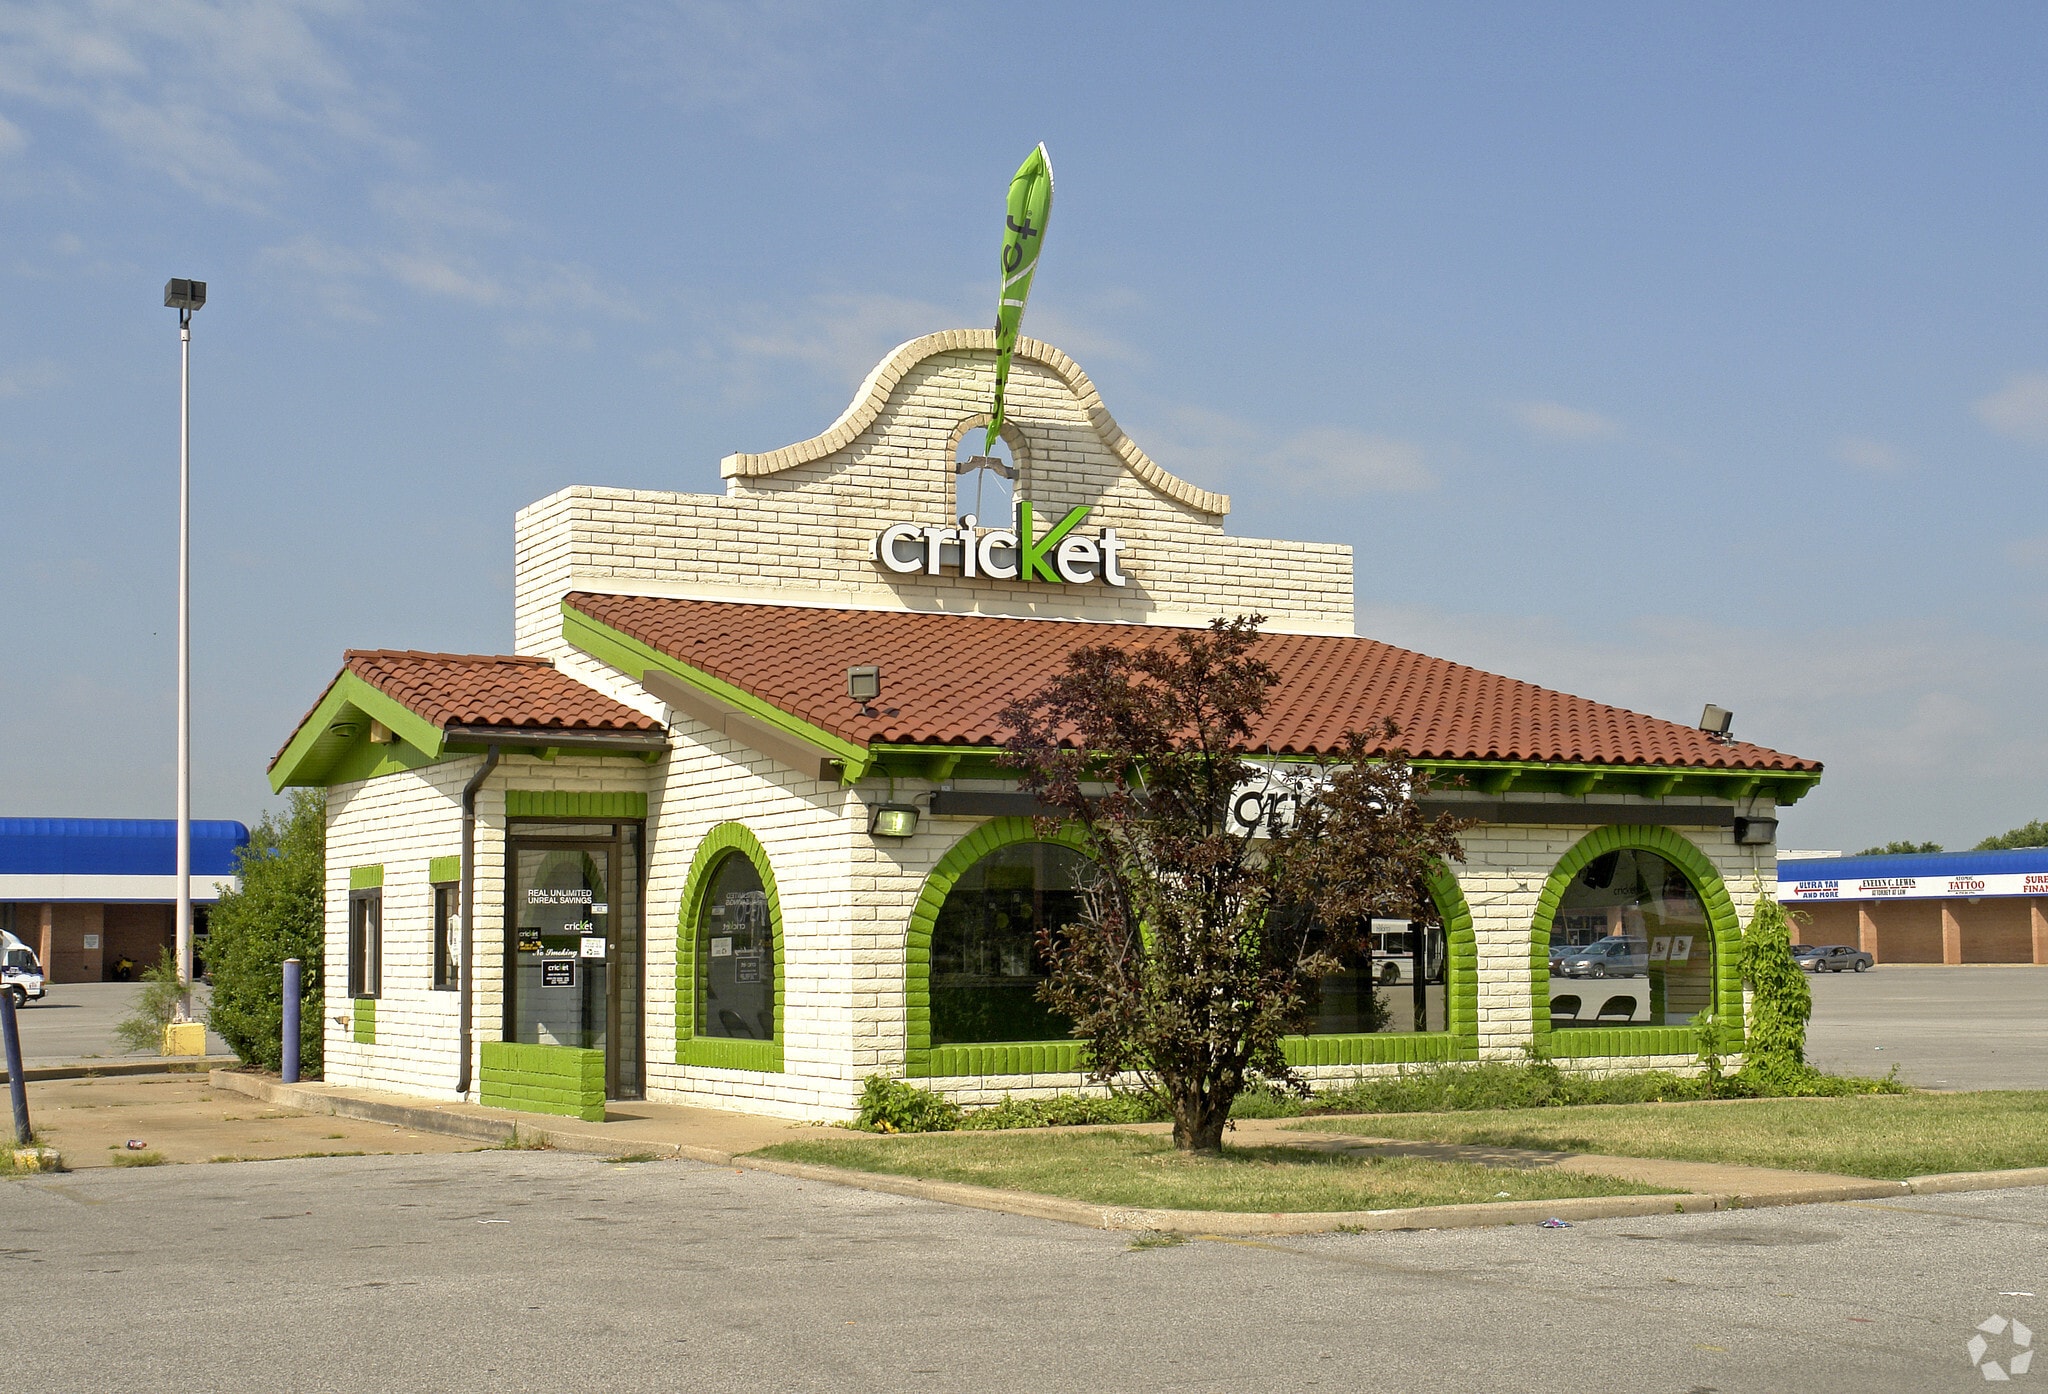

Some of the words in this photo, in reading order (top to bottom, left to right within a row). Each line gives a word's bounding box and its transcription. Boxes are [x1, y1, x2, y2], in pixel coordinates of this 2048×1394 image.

[879, 501, 1126, 587] cricket
[1799, 881, 1823, 889] ULTRA
[1825, 880, 1839, 888] TAN
[1862, 879, 1887, 887] EVELYN
[1895, 878, 1916, 886] LEWIS
[1948, 880, 1985, 890] TATTOO
[528, 889, 549, 897] REAL
[550, 889, 592, 897] UNLIMITED
[564, 920, 593, 931] cricket
